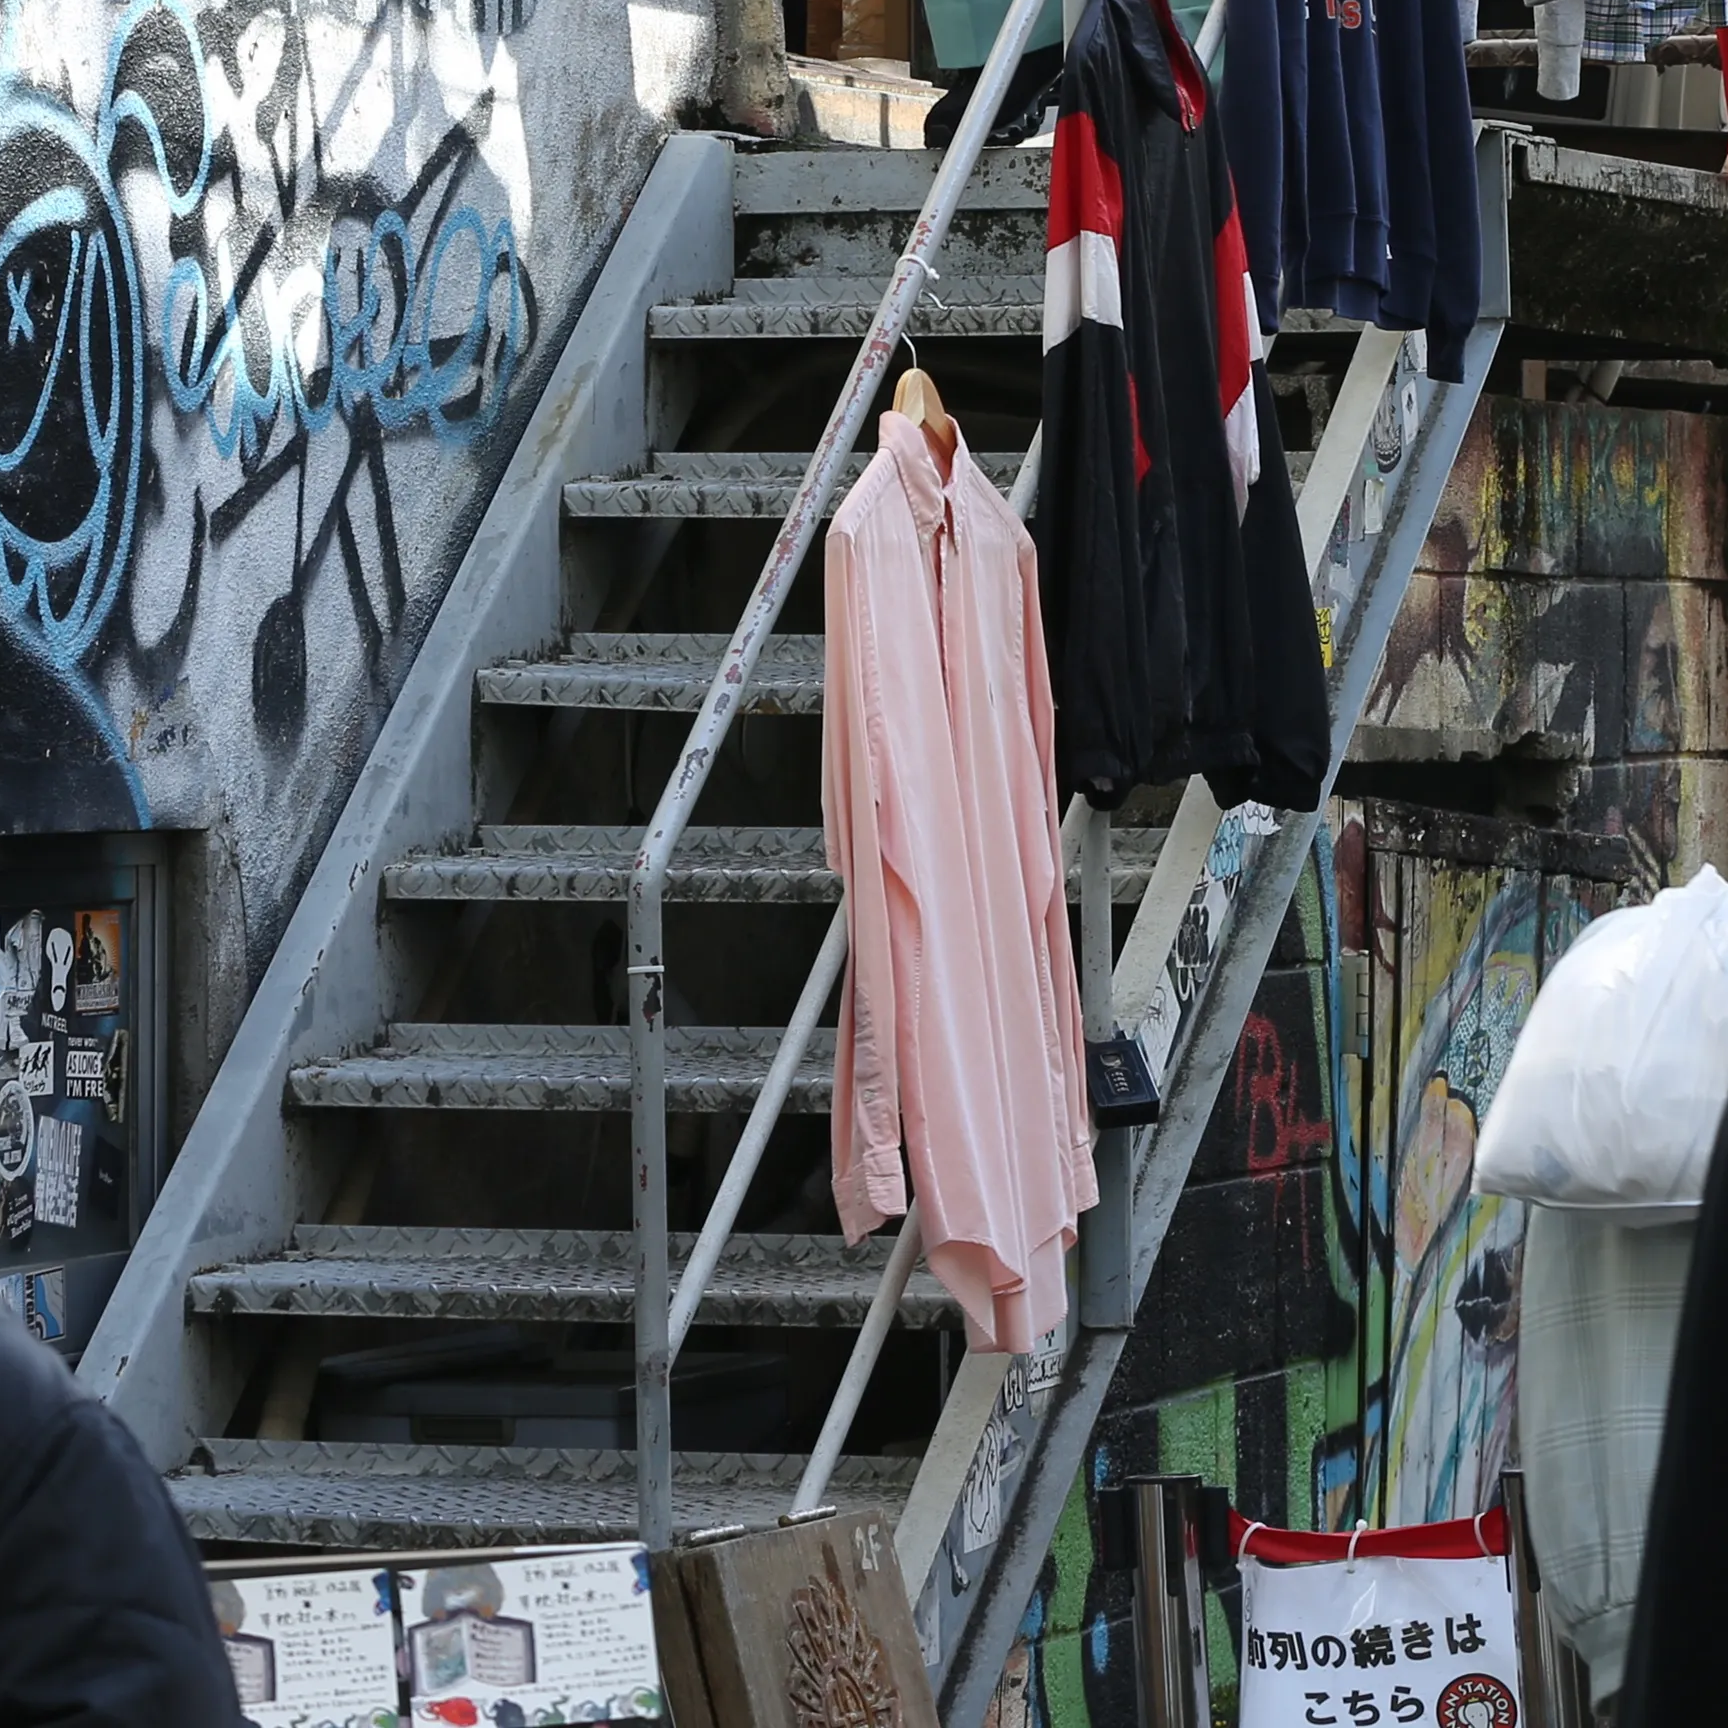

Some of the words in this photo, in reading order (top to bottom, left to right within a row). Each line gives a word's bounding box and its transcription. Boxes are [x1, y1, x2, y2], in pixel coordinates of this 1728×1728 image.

[78, 1053, 99, 1075] LONG
[66, 1079, 82, 1097] I'M
[84, 1079, 104, 1097] FRE
[1247, 1612, 1487, 1672] 前列の続きは
[1304, 1685, 1425, 1727] こちら
[1457, 1681, 1510, 1725] STATION
